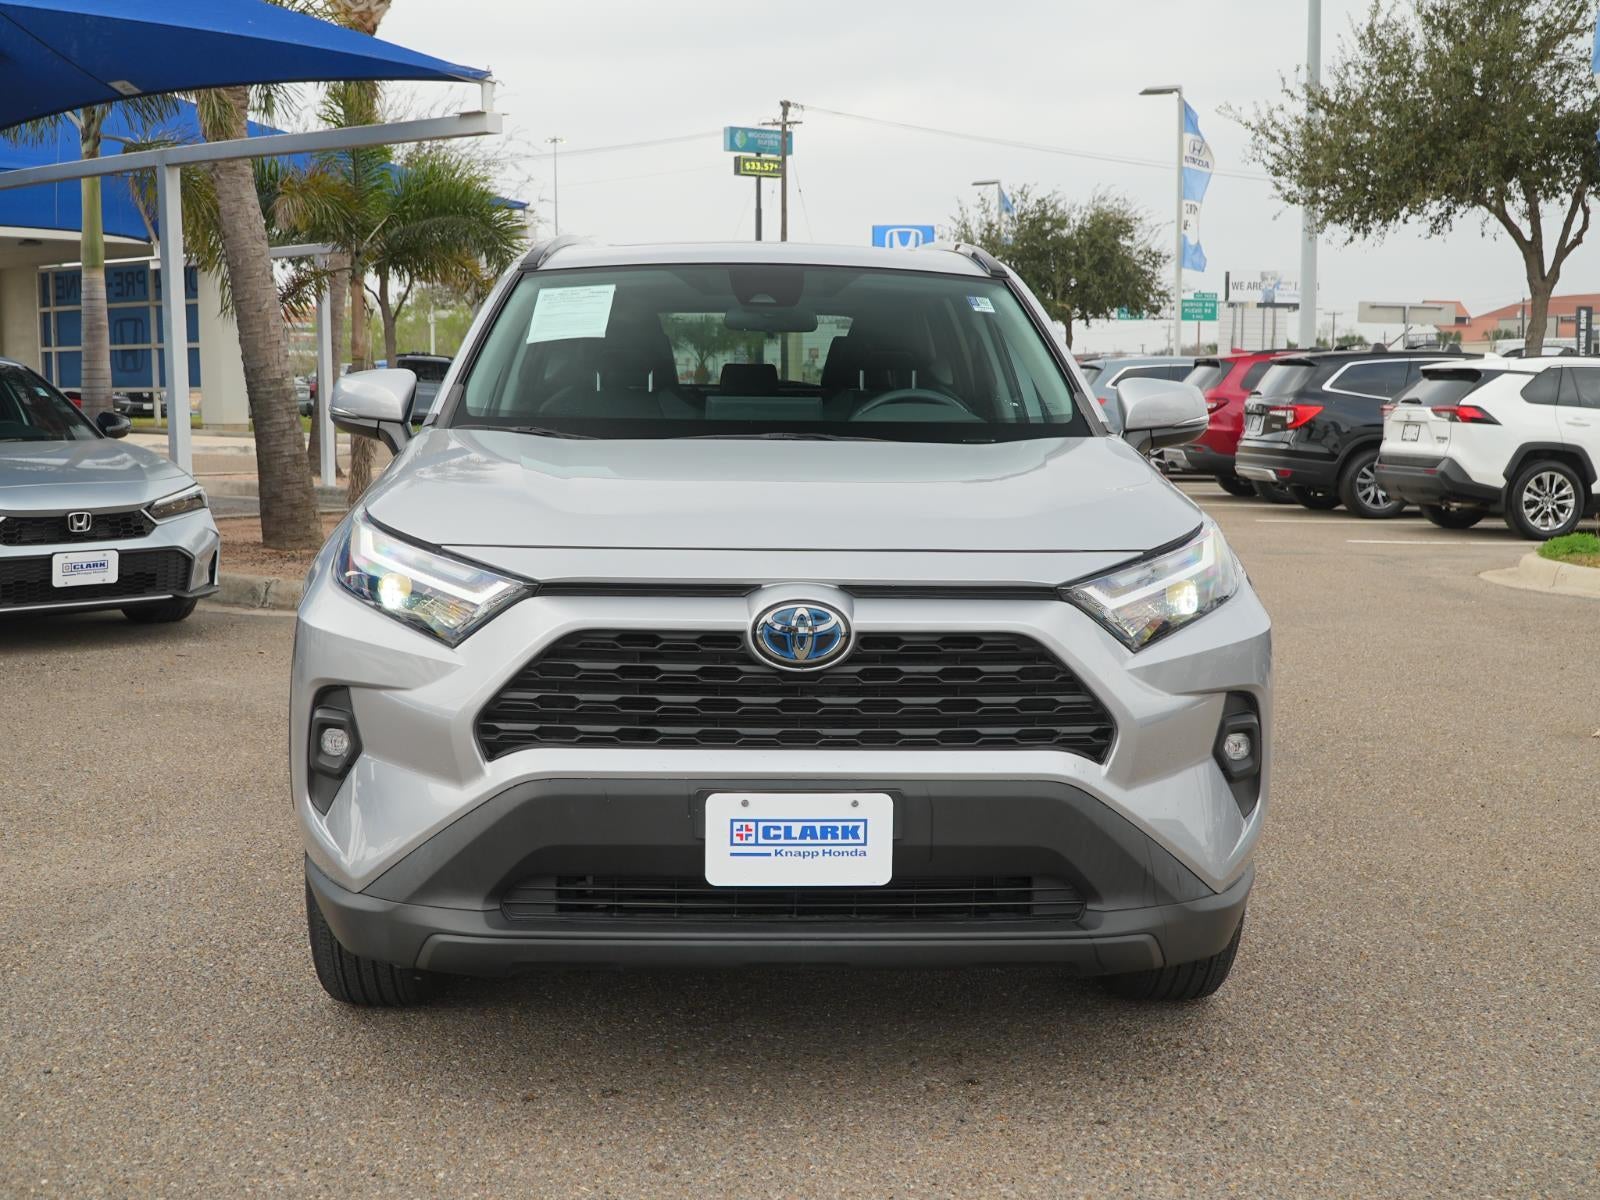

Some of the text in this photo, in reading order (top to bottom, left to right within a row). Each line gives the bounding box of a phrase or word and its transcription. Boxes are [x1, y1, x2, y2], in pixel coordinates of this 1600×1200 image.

[1231, 281, 1262, 290] WE ARE
[73, 562, 106, 570] CLARK
[762, 825, 861, 840] CLARK
[774, 848, 867, 859] Knapp Honda
